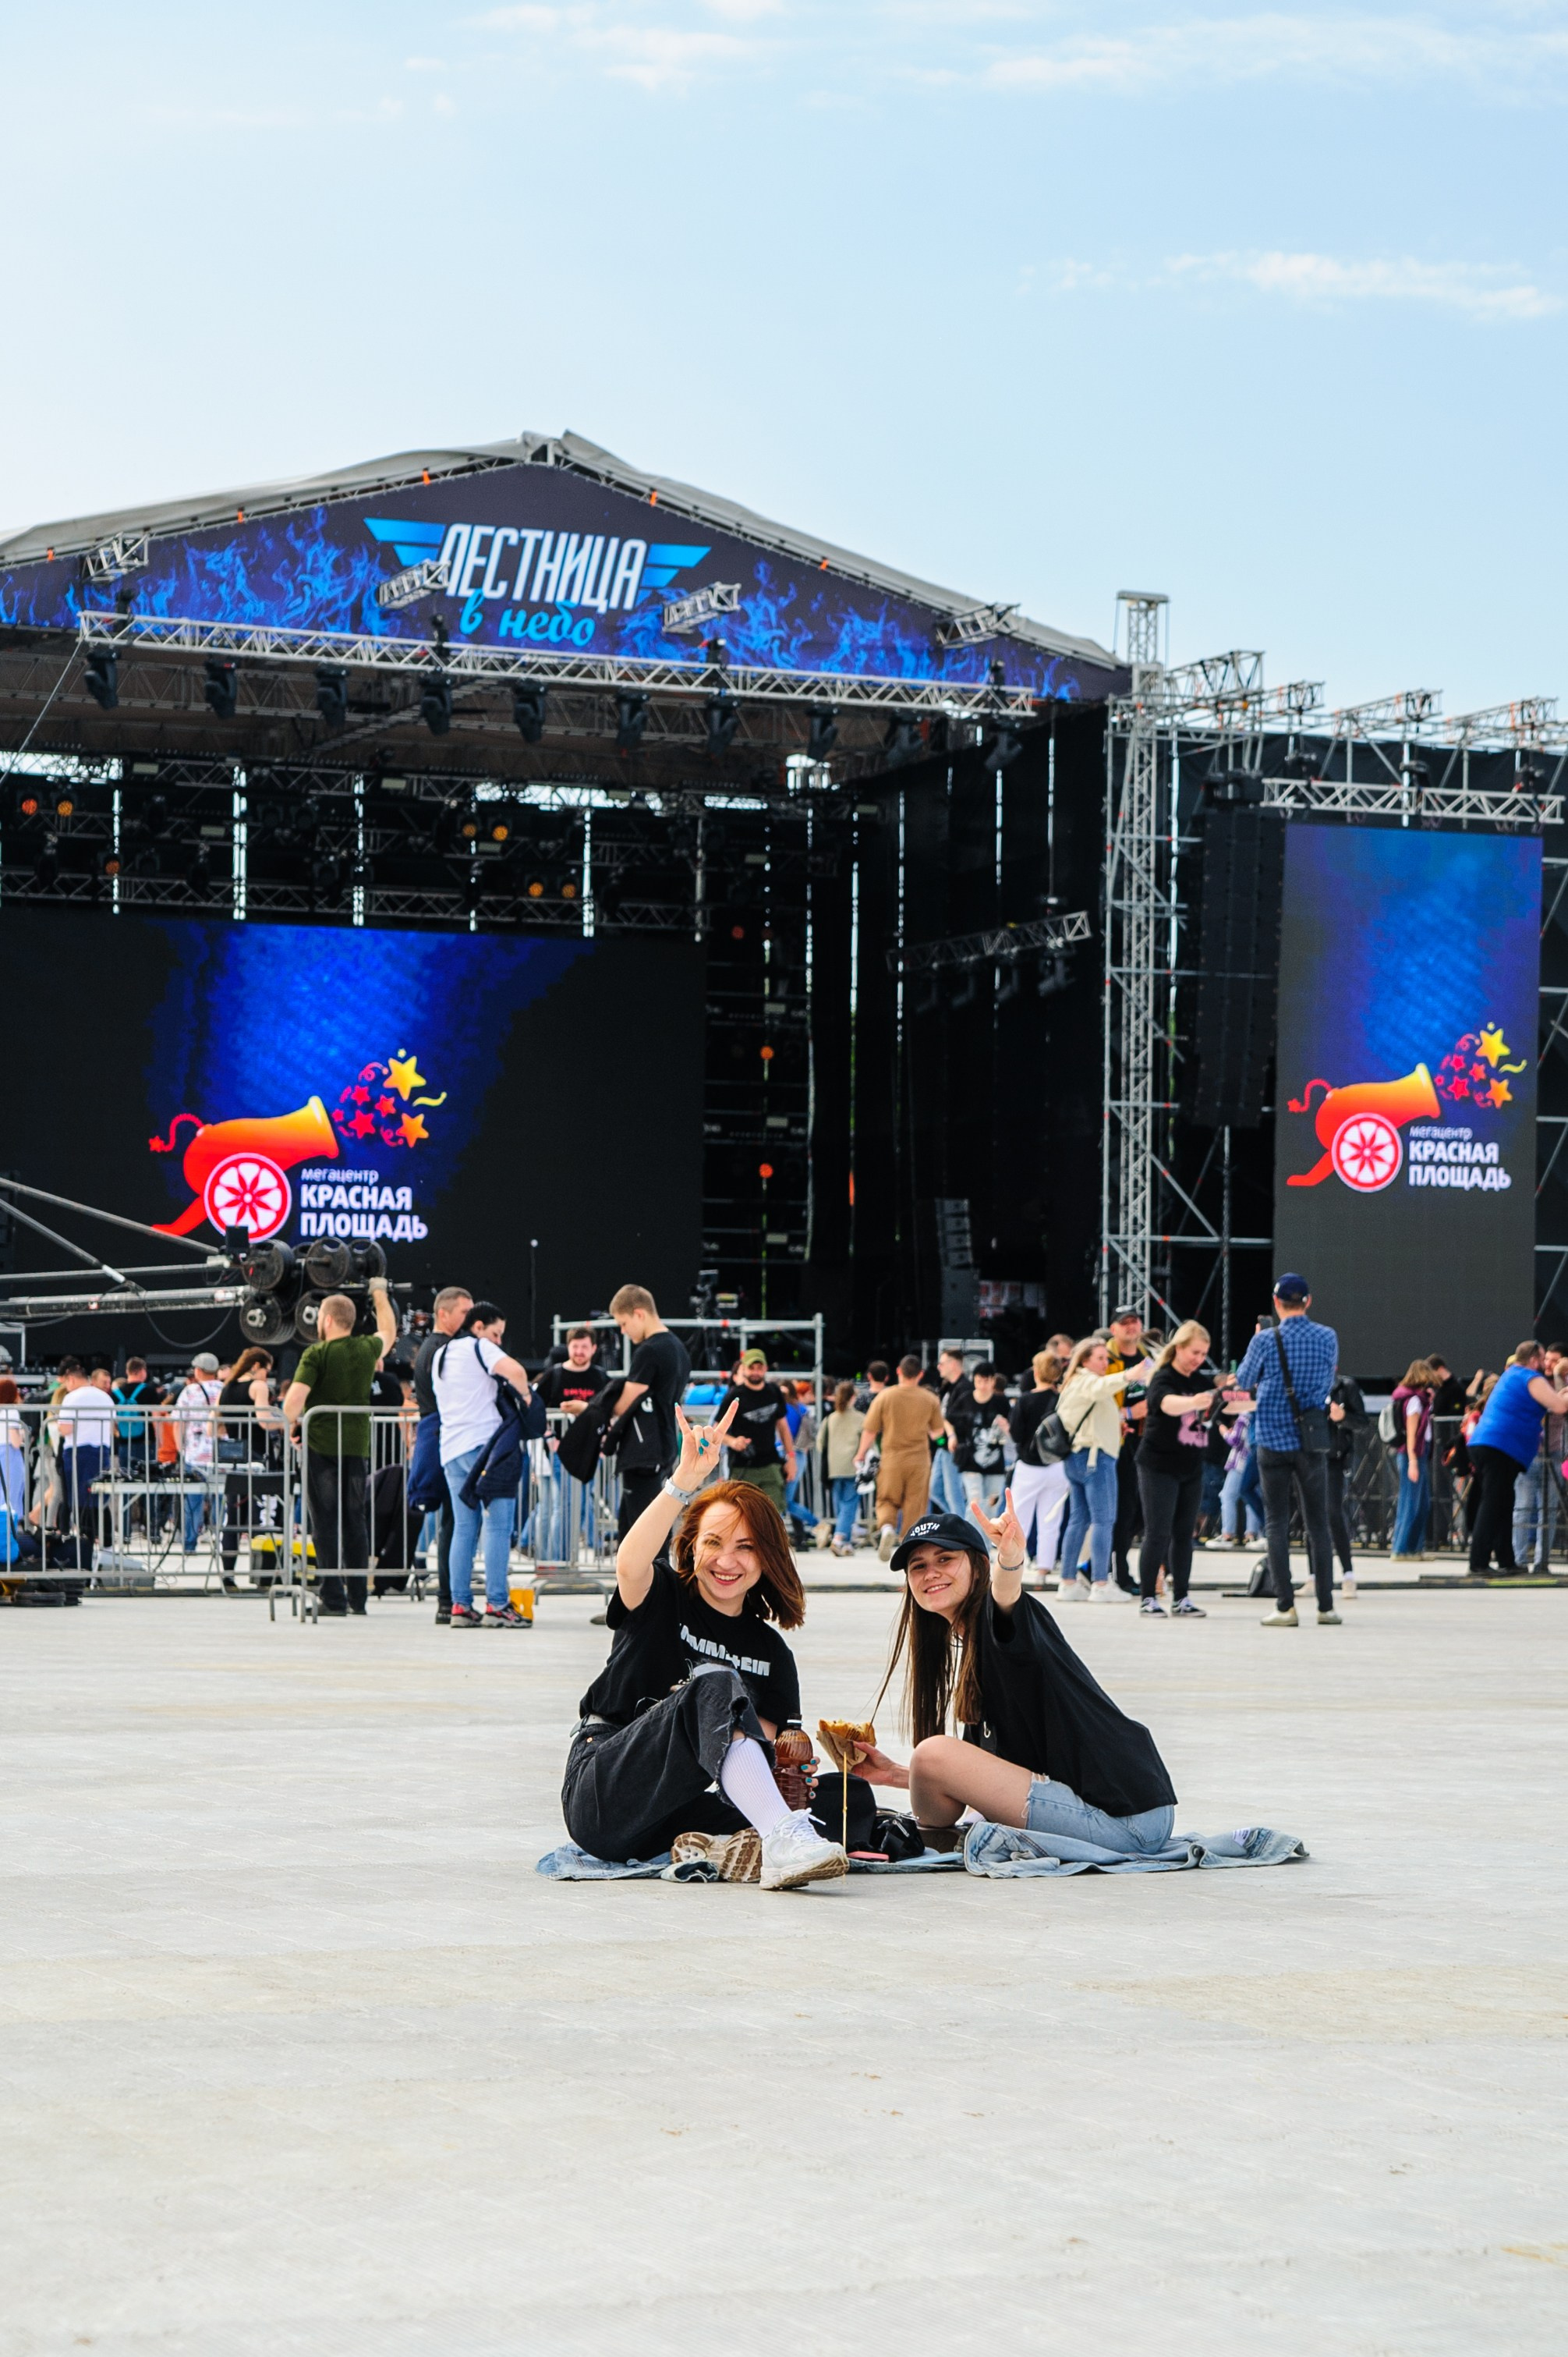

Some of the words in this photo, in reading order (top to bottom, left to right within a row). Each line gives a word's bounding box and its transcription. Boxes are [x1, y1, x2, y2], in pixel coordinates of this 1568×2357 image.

[438, 523, 646, 614] ЛЕСТНИЦА
[498, 601, 595, 646] небо
[1409, 1125, 1473, 1141] мегацентр
[1408, 1140, 1499, 1164] КРАСНАЯ
[301, 1168, 379, 1186] мегацентр
[1408, 1164, 1512, 1191] ПЛОЩАДЬ
[301, 1184, 412, 1210] КРАСНАЯ
[300, 1212, 428, 1242] ПЛОЩАДЬ
